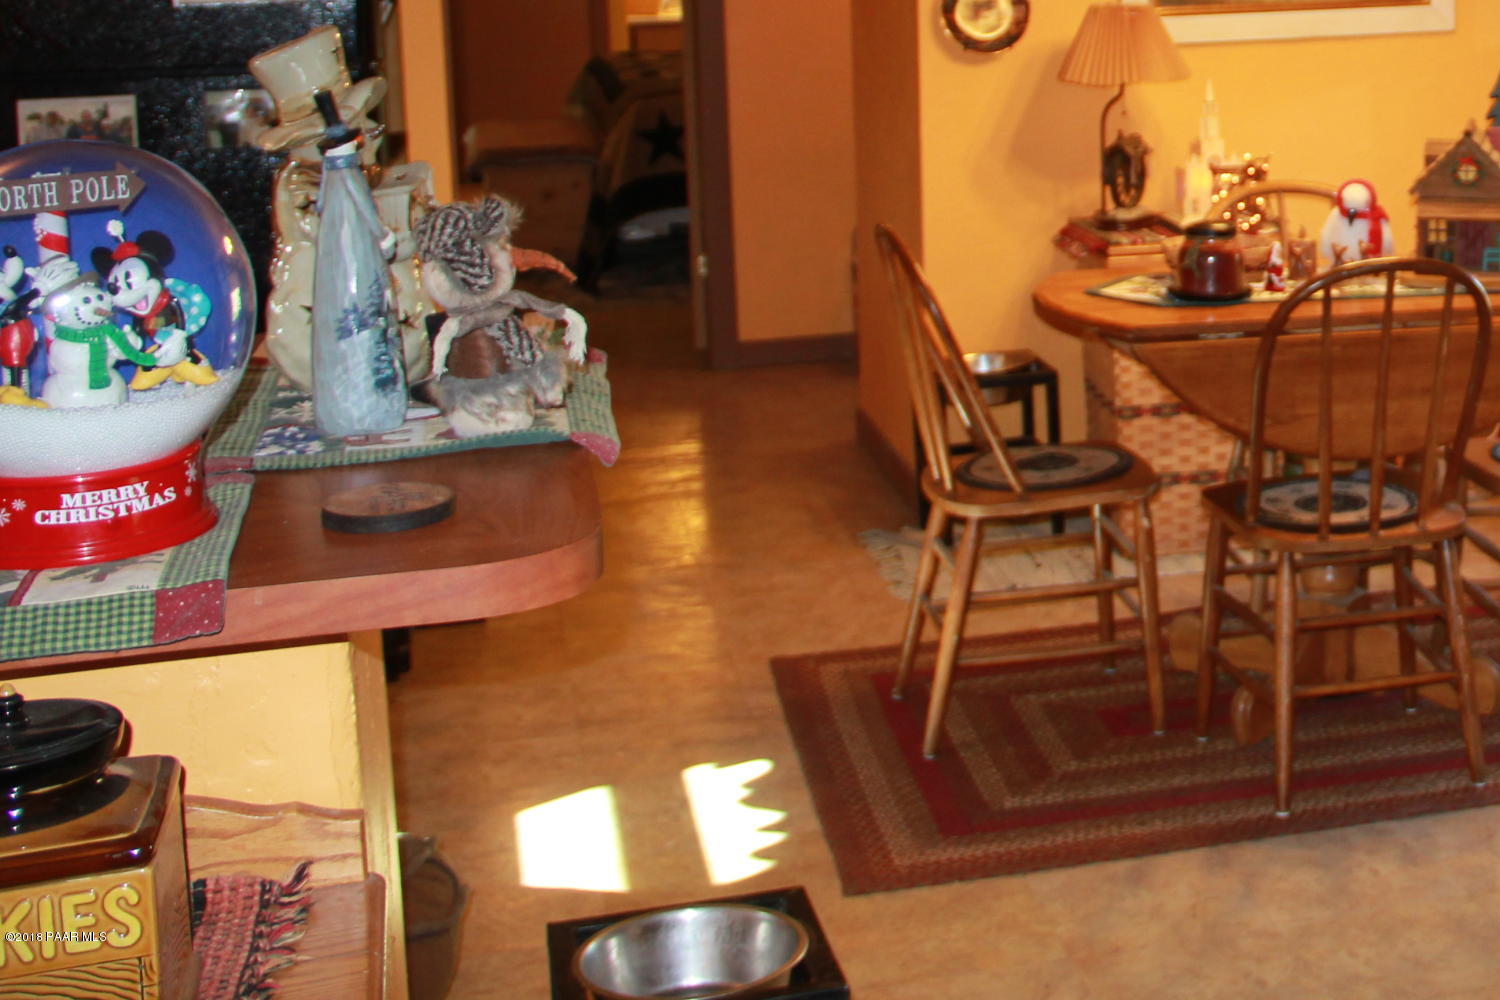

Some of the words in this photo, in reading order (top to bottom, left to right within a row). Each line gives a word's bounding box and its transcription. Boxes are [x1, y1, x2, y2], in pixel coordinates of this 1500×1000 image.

[70, 175, 130, 203] POLE
[35, 486, 176, 525] CHRISTMAS
[61, 481, 149, 509] MERRY
